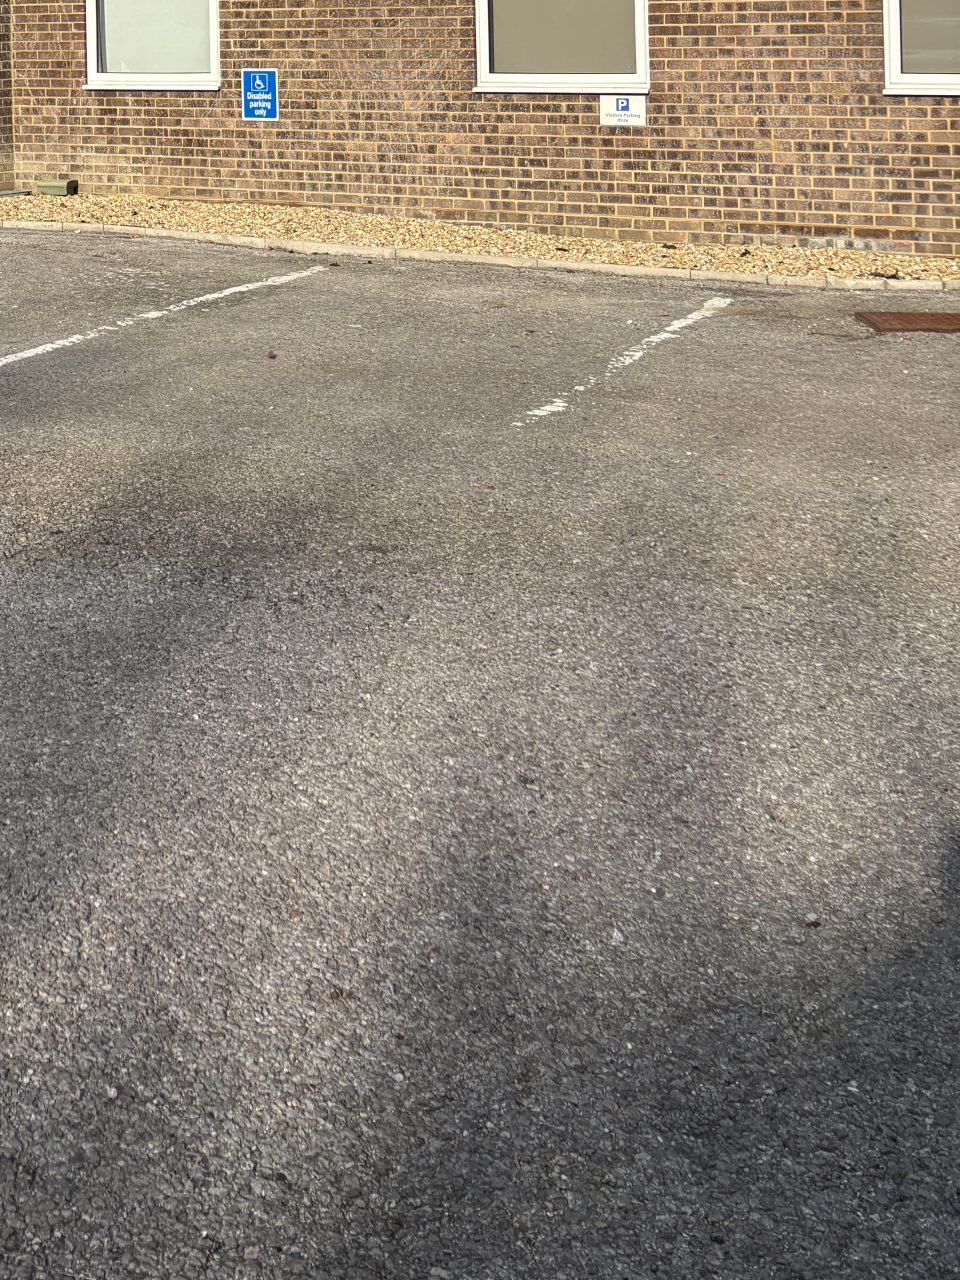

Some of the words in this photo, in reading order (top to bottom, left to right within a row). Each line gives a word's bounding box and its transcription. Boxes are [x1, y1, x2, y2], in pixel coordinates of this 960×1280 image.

[250, 100, 271, 109] parking
[619, 100, 627, 110] P
[254, 109, 266, 117] only
